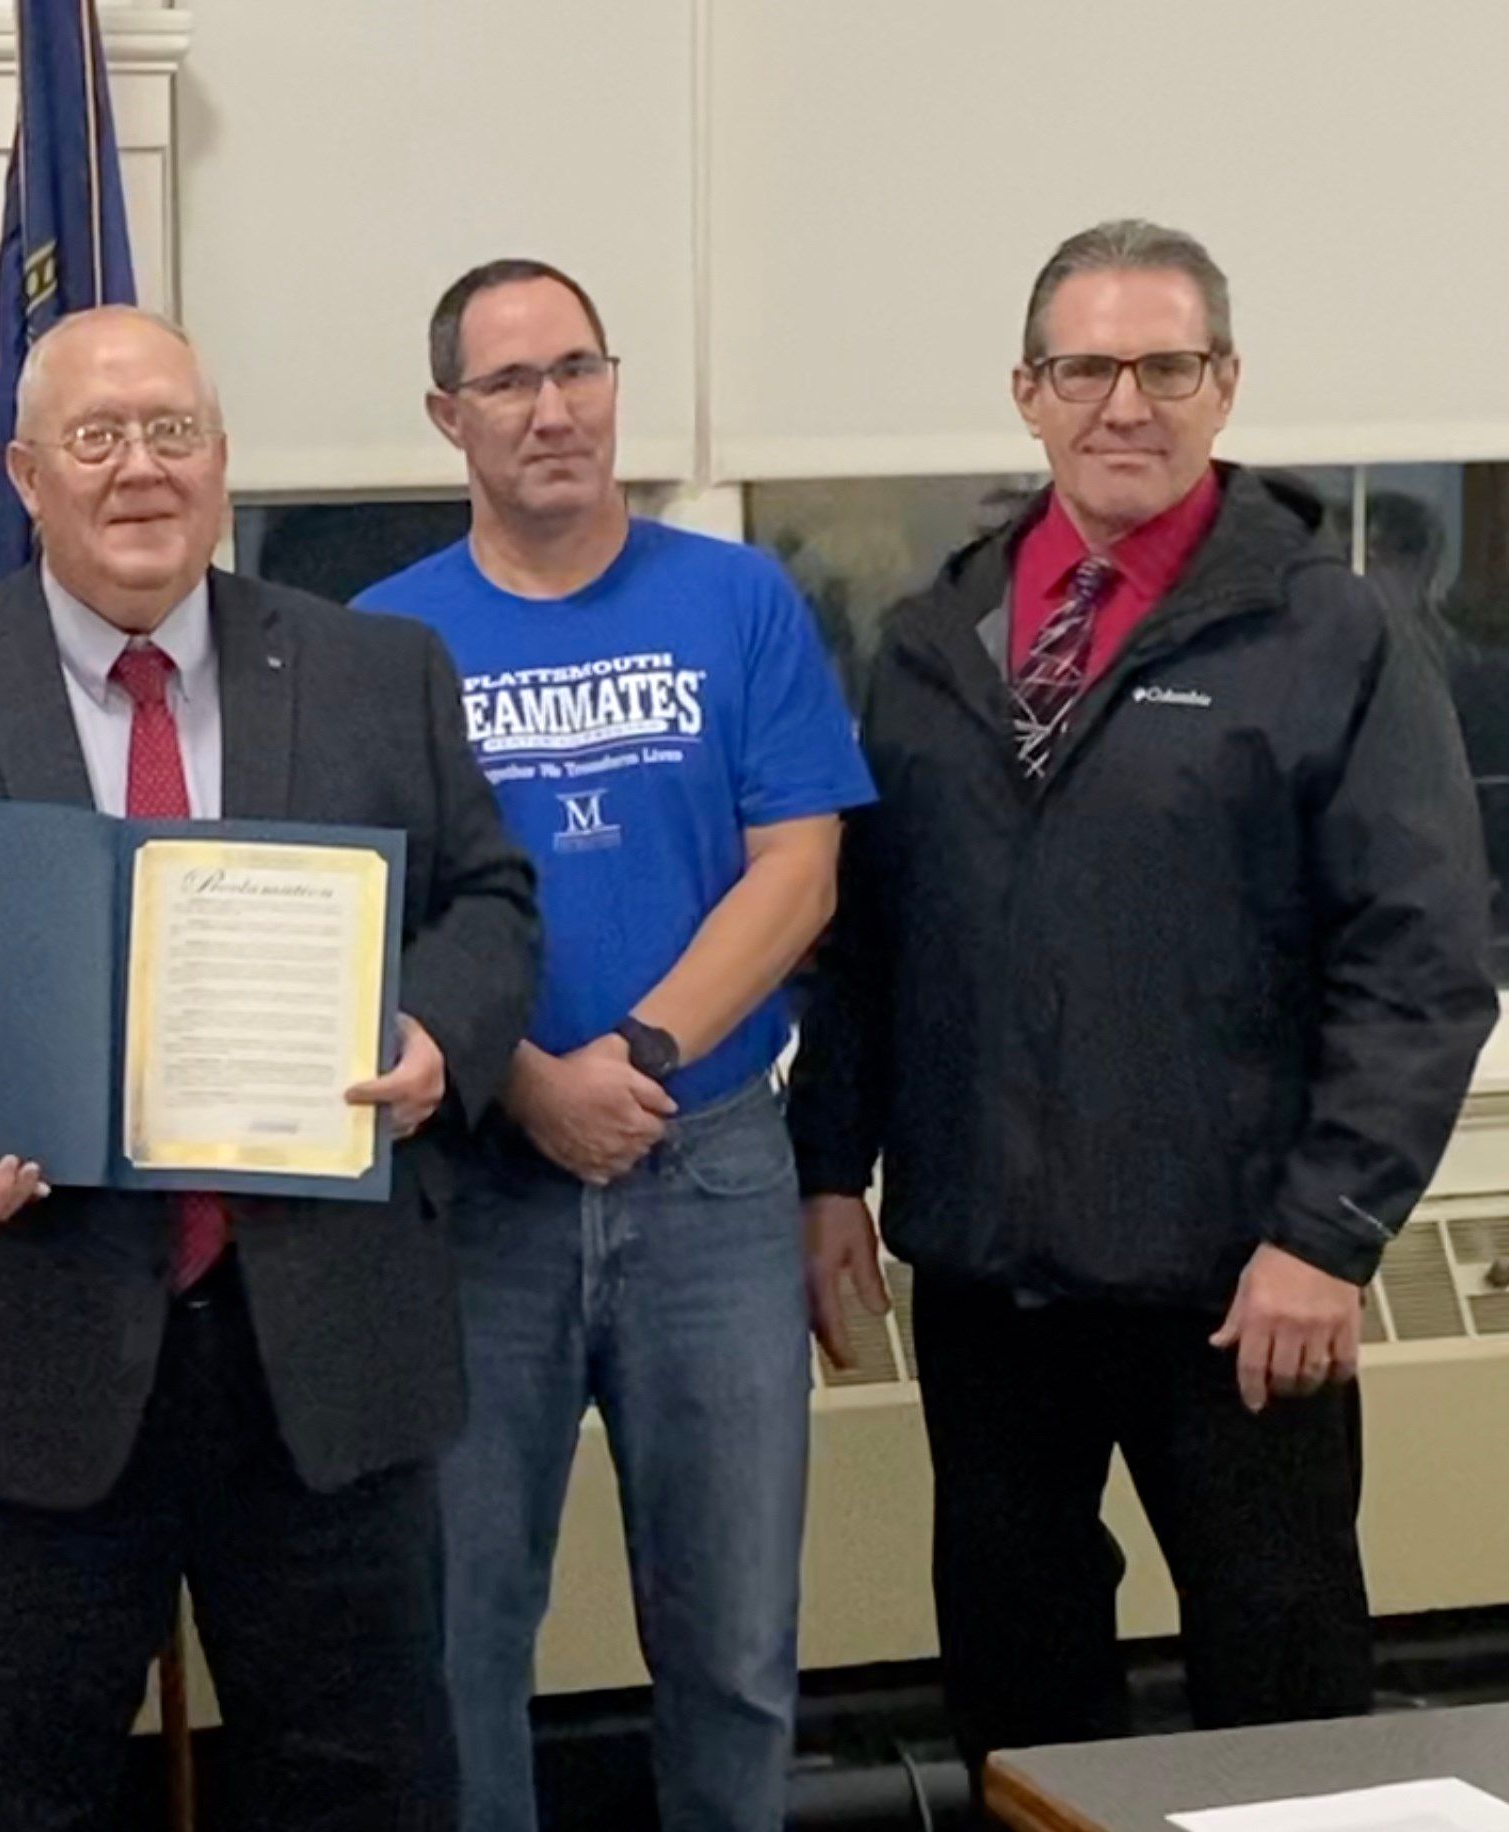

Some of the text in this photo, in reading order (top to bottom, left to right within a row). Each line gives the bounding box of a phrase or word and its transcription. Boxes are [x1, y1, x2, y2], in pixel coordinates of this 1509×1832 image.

[462, 652, 673, 692] PLATTSMOUTH
[462, 670, 702, 742] EAMMATES
[1147, 686, 1211, 706] Columbia
[556, 788, 609, 834] M
[181, 867, 334, 898] Proclamation
